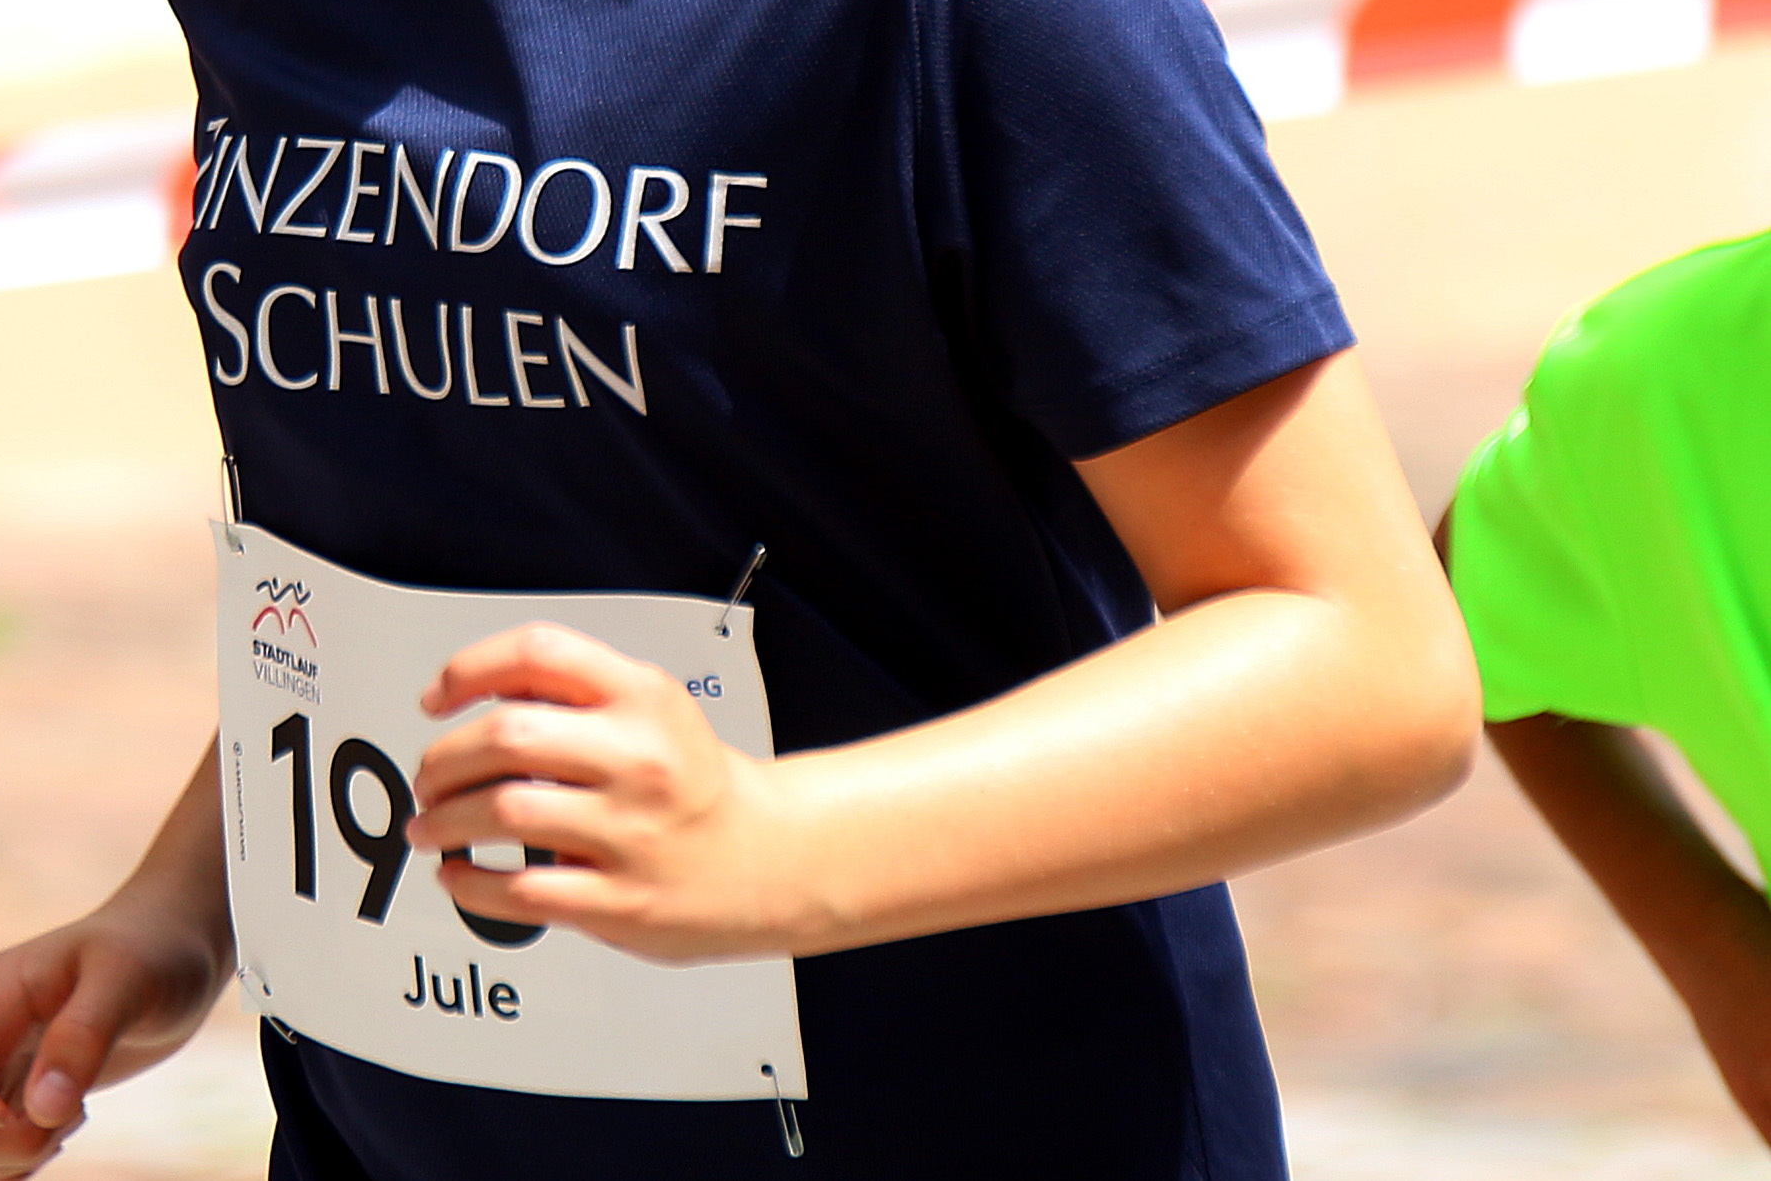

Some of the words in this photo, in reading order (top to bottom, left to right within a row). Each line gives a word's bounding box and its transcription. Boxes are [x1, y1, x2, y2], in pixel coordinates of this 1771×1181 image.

[202, 262, 648, 417] SCHULEN
[252, 638, 319, 681] STADTLAUF
[253, 661, 321, 706] VILLINGEN
[686, 674, 723, 698] eG
[271, 712, 556, 948] 19
[403, 955, 522, 1023] Jule
